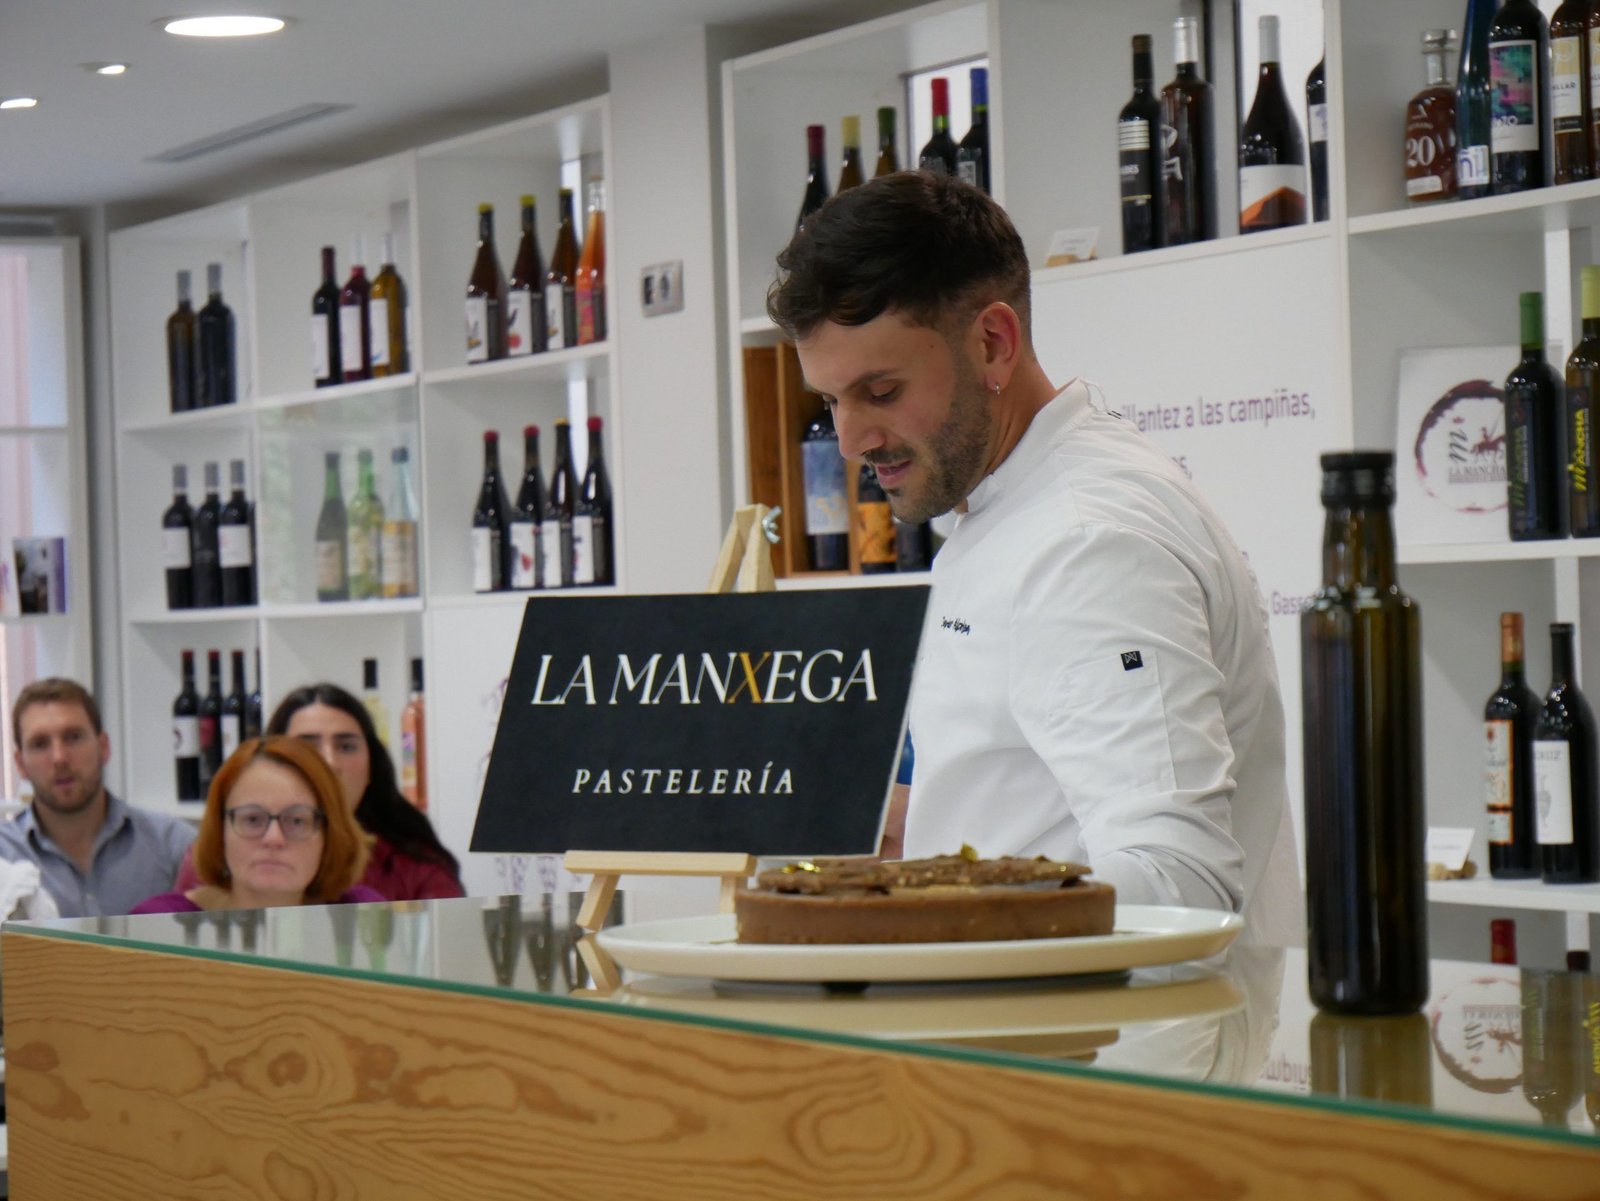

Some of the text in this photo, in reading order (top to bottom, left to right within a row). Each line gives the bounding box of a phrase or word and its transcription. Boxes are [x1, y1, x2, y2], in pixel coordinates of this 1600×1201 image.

[1405, 135, 1436, 168] 20
[1185, 405, 1195, 428] a
[1199, 396, 1225, 426] las
[1228, 388, 1316, 428] campiñas,
[531, 648, 878, 705] LA MANXEGA
[571, 761, 794, 794] PASTELERÍA
